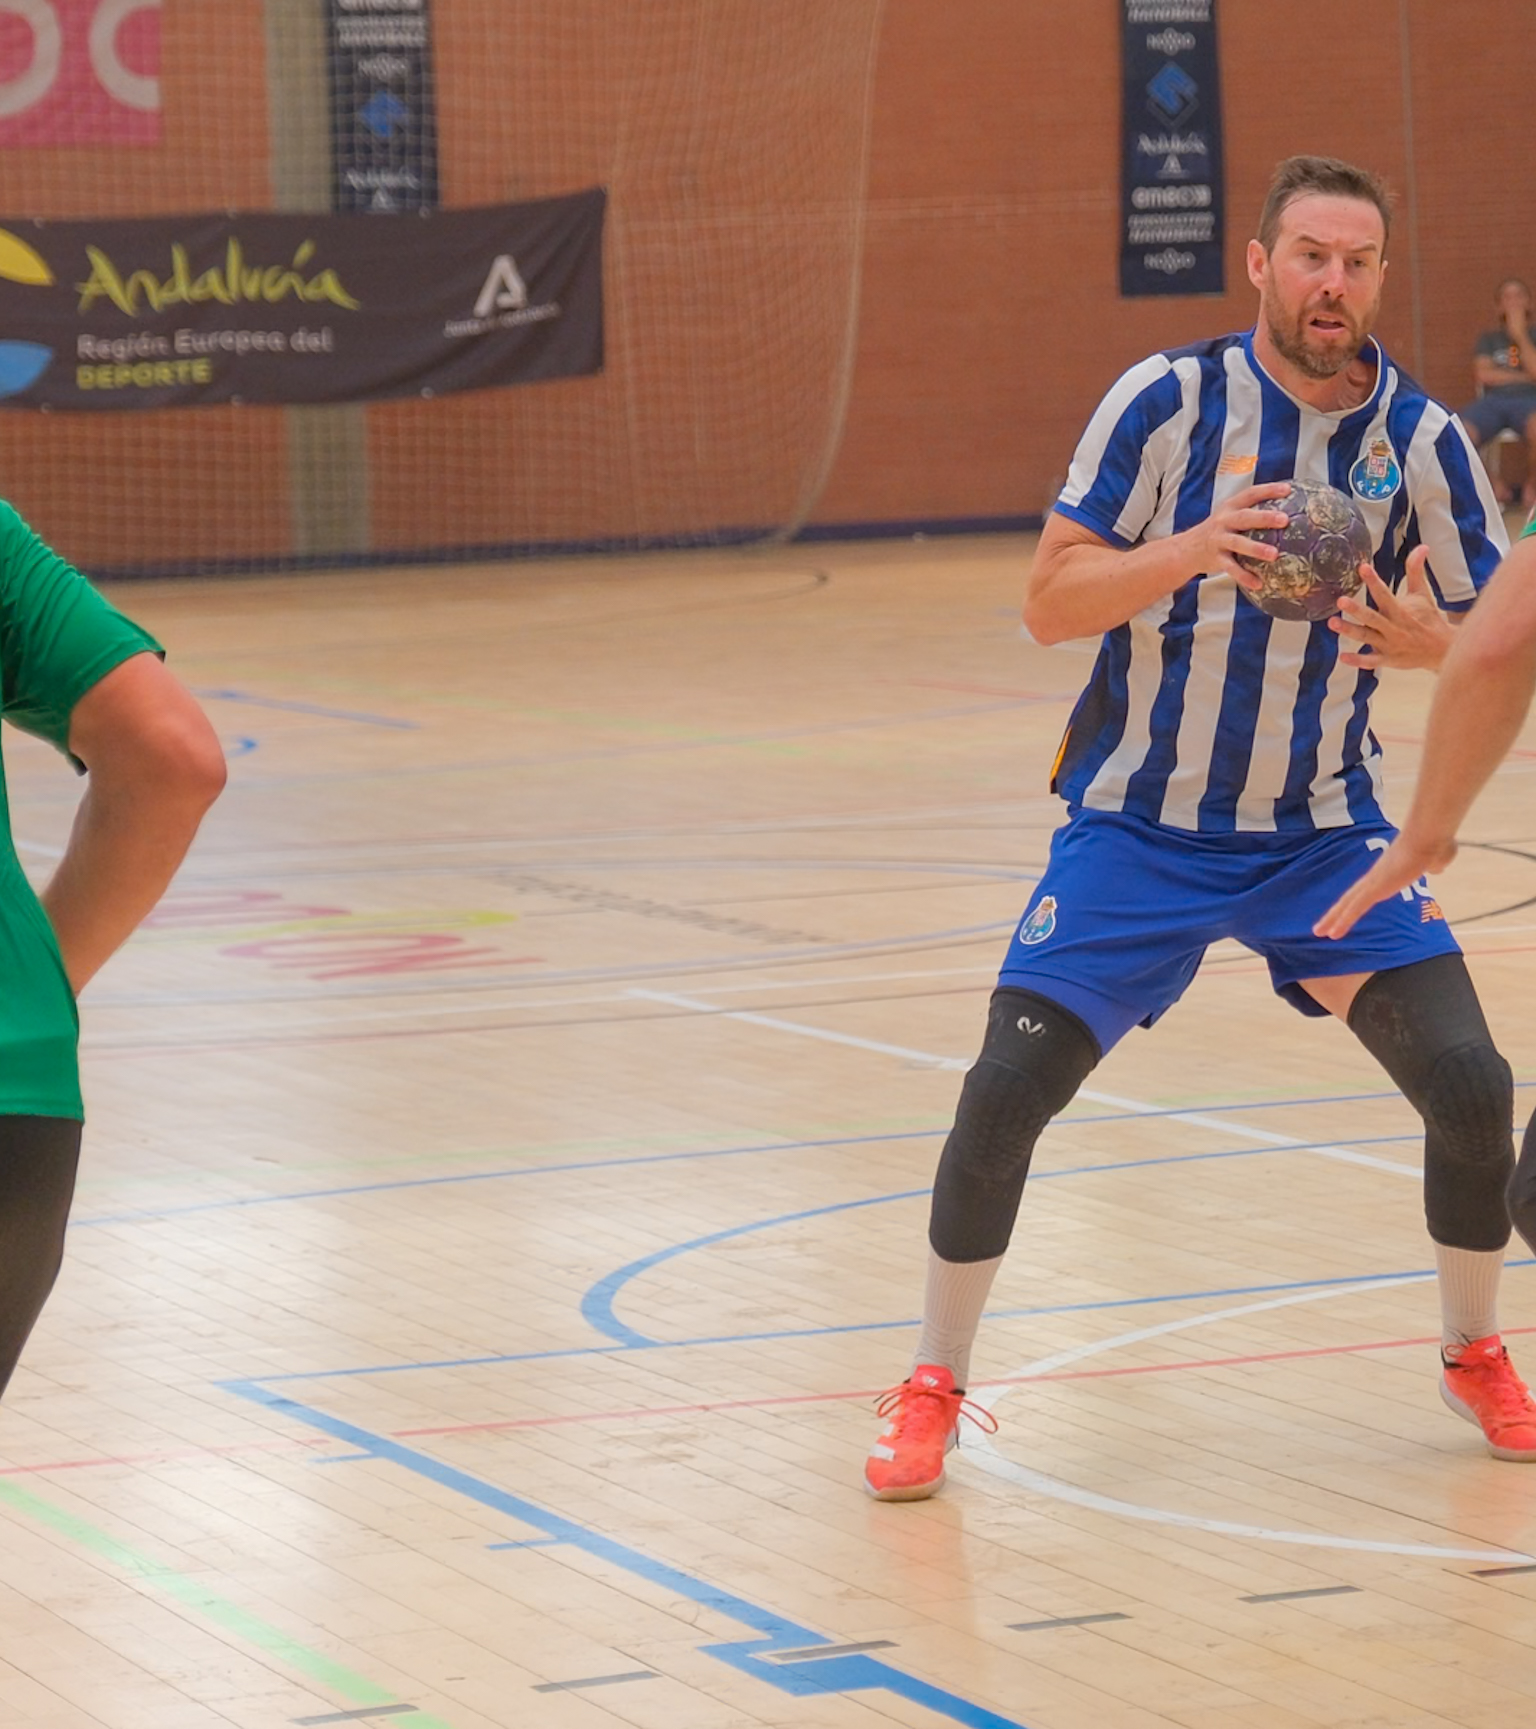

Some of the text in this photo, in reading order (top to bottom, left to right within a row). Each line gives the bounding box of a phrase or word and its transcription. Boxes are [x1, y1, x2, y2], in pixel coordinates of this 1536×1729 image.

[75, 234, 361, 318] Andalucía
[77, 325, 335, 364] Región Europea del
[76, 357, 213, 390] DEPORTE
